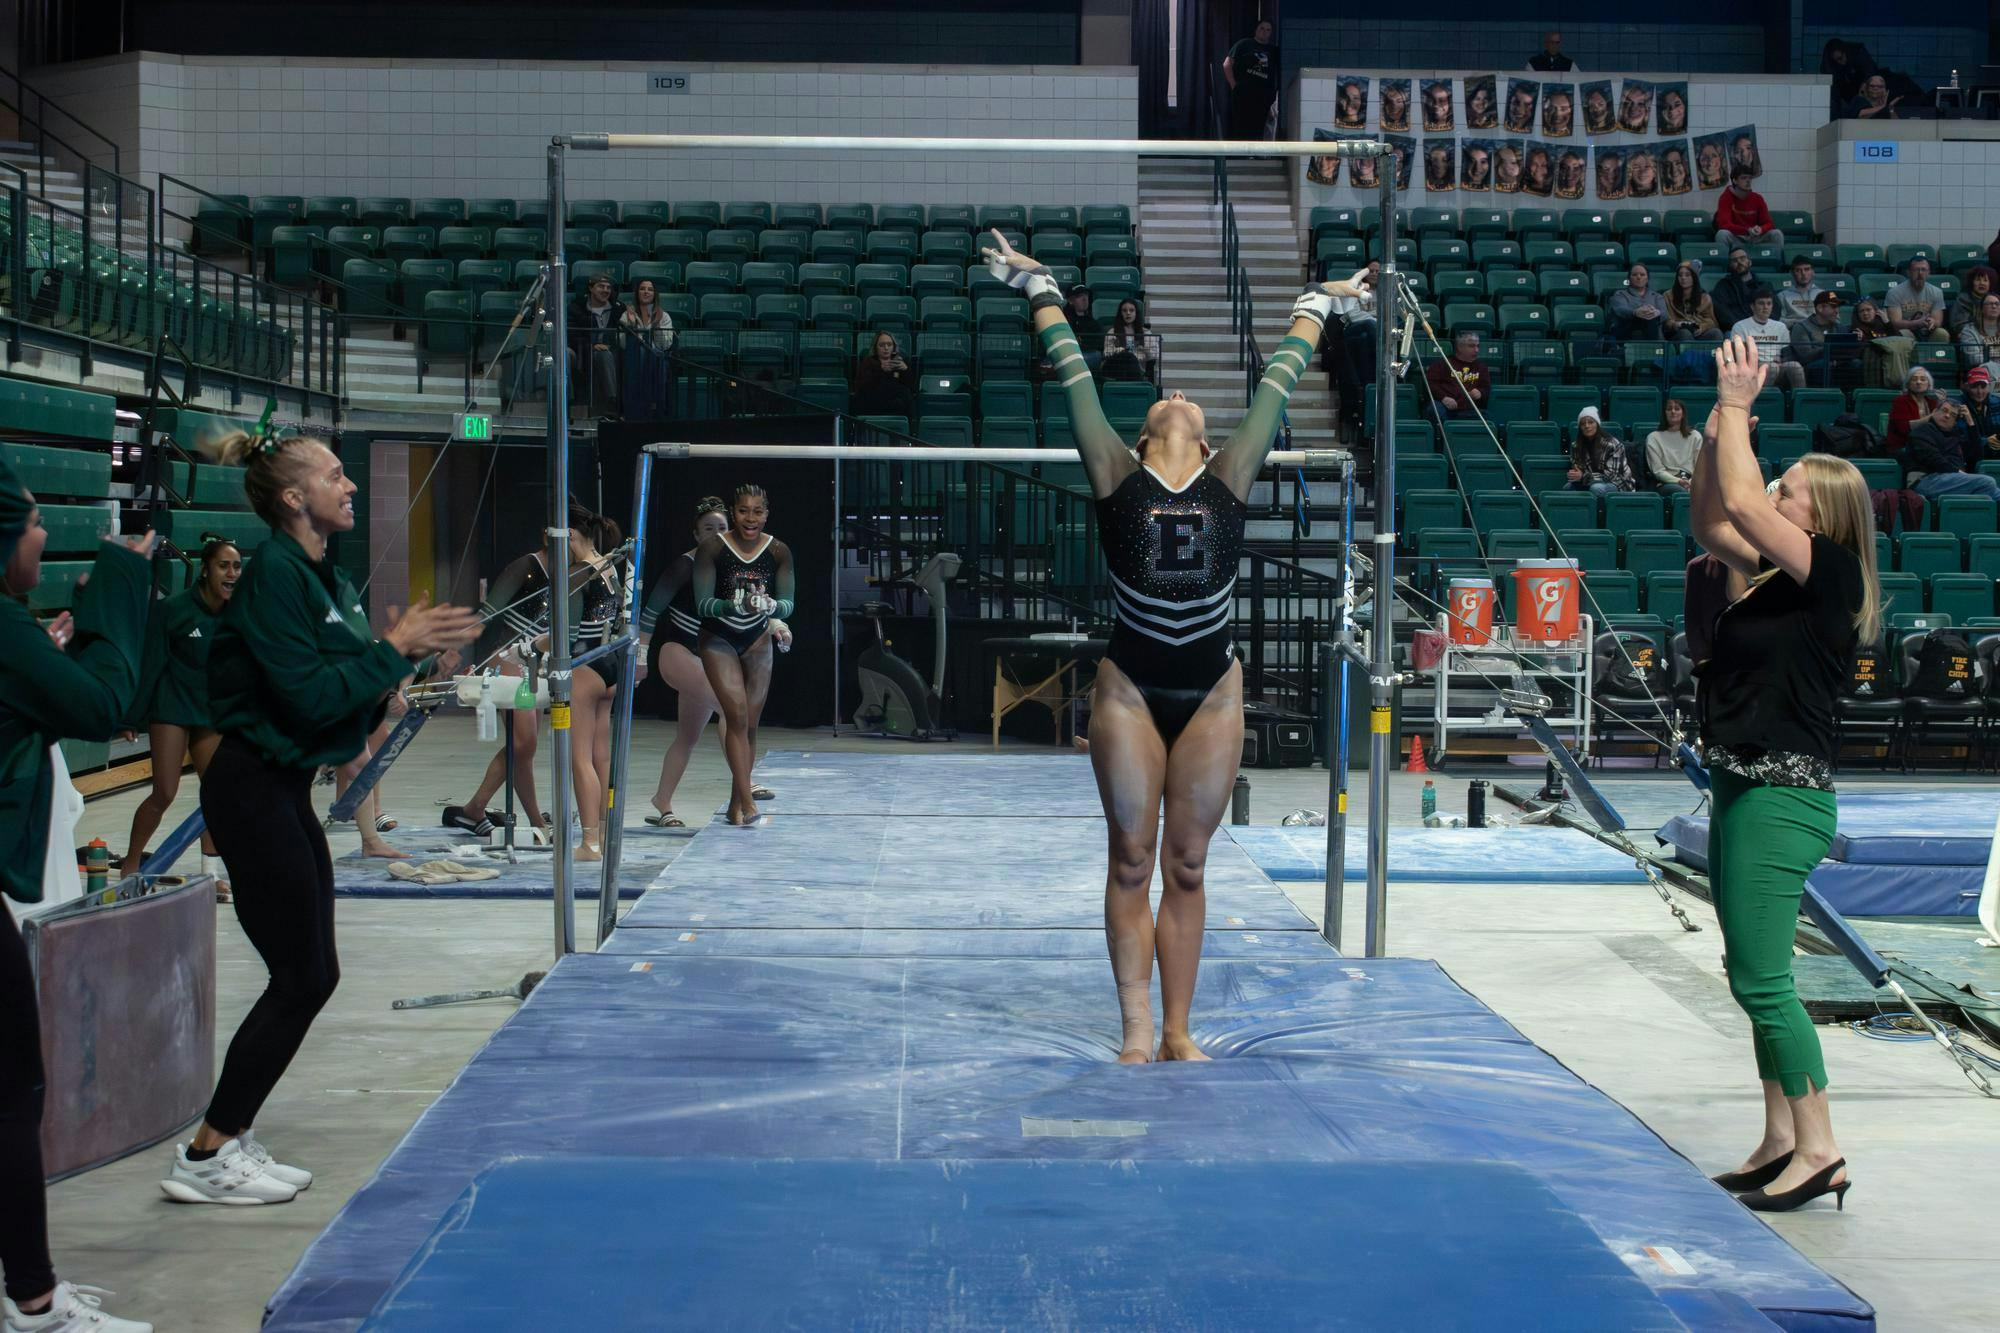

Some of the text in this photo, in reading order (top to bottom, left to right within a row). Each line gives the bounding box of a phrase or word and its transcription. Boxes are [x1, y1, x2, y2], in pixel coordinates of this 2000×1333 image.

[654, 78, 685, 89] 109
[1861, 146, 1893, 157] 108
[465, 417, 488, 438] EXIT
[1153, 513, 1205, 571] E
[1540, 581, 1559, 602] G
[1461, 594, 1477, 609] G
[1951, 656, 1968, 664] FIRE
[1947, 670, 1969, 678] CHIPS
